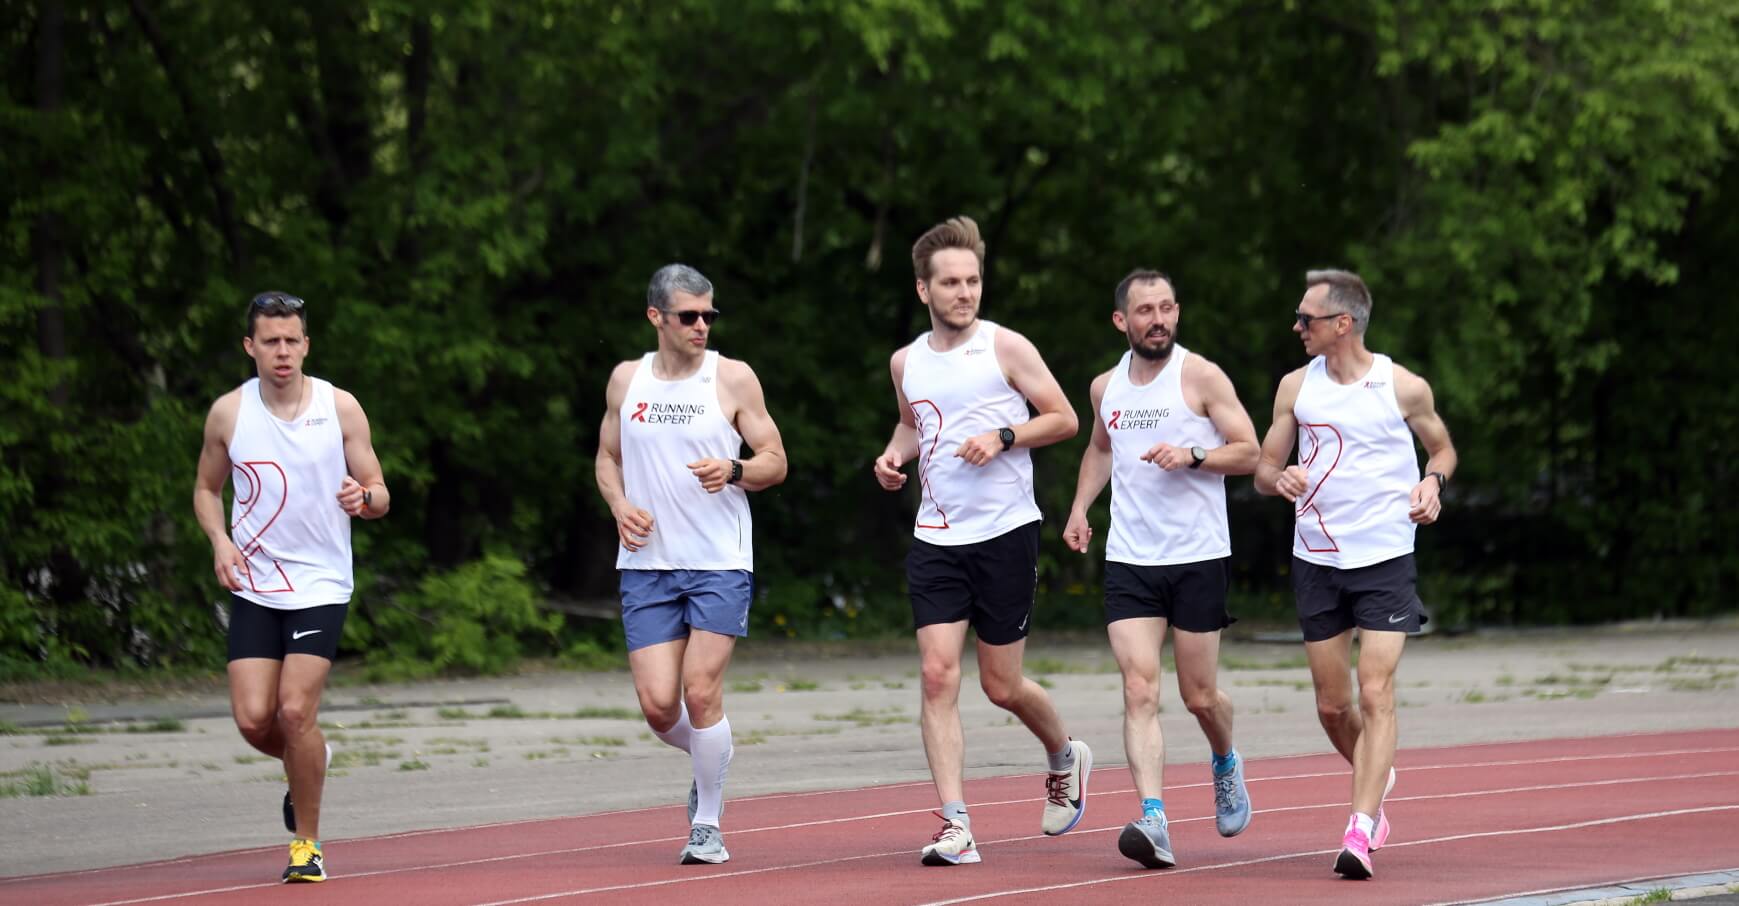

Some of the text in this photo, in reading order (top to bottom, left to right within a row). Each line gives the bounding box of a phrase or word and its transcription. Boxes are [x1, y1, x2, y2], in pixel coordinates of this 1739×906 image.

[651, 402, 705, 415] RUNNING
[1124, 408, 1170, 419] RUNNING
[648, 413, 695, 424] EXPERT
[1120, 419, 1160, 430] EXPERT
